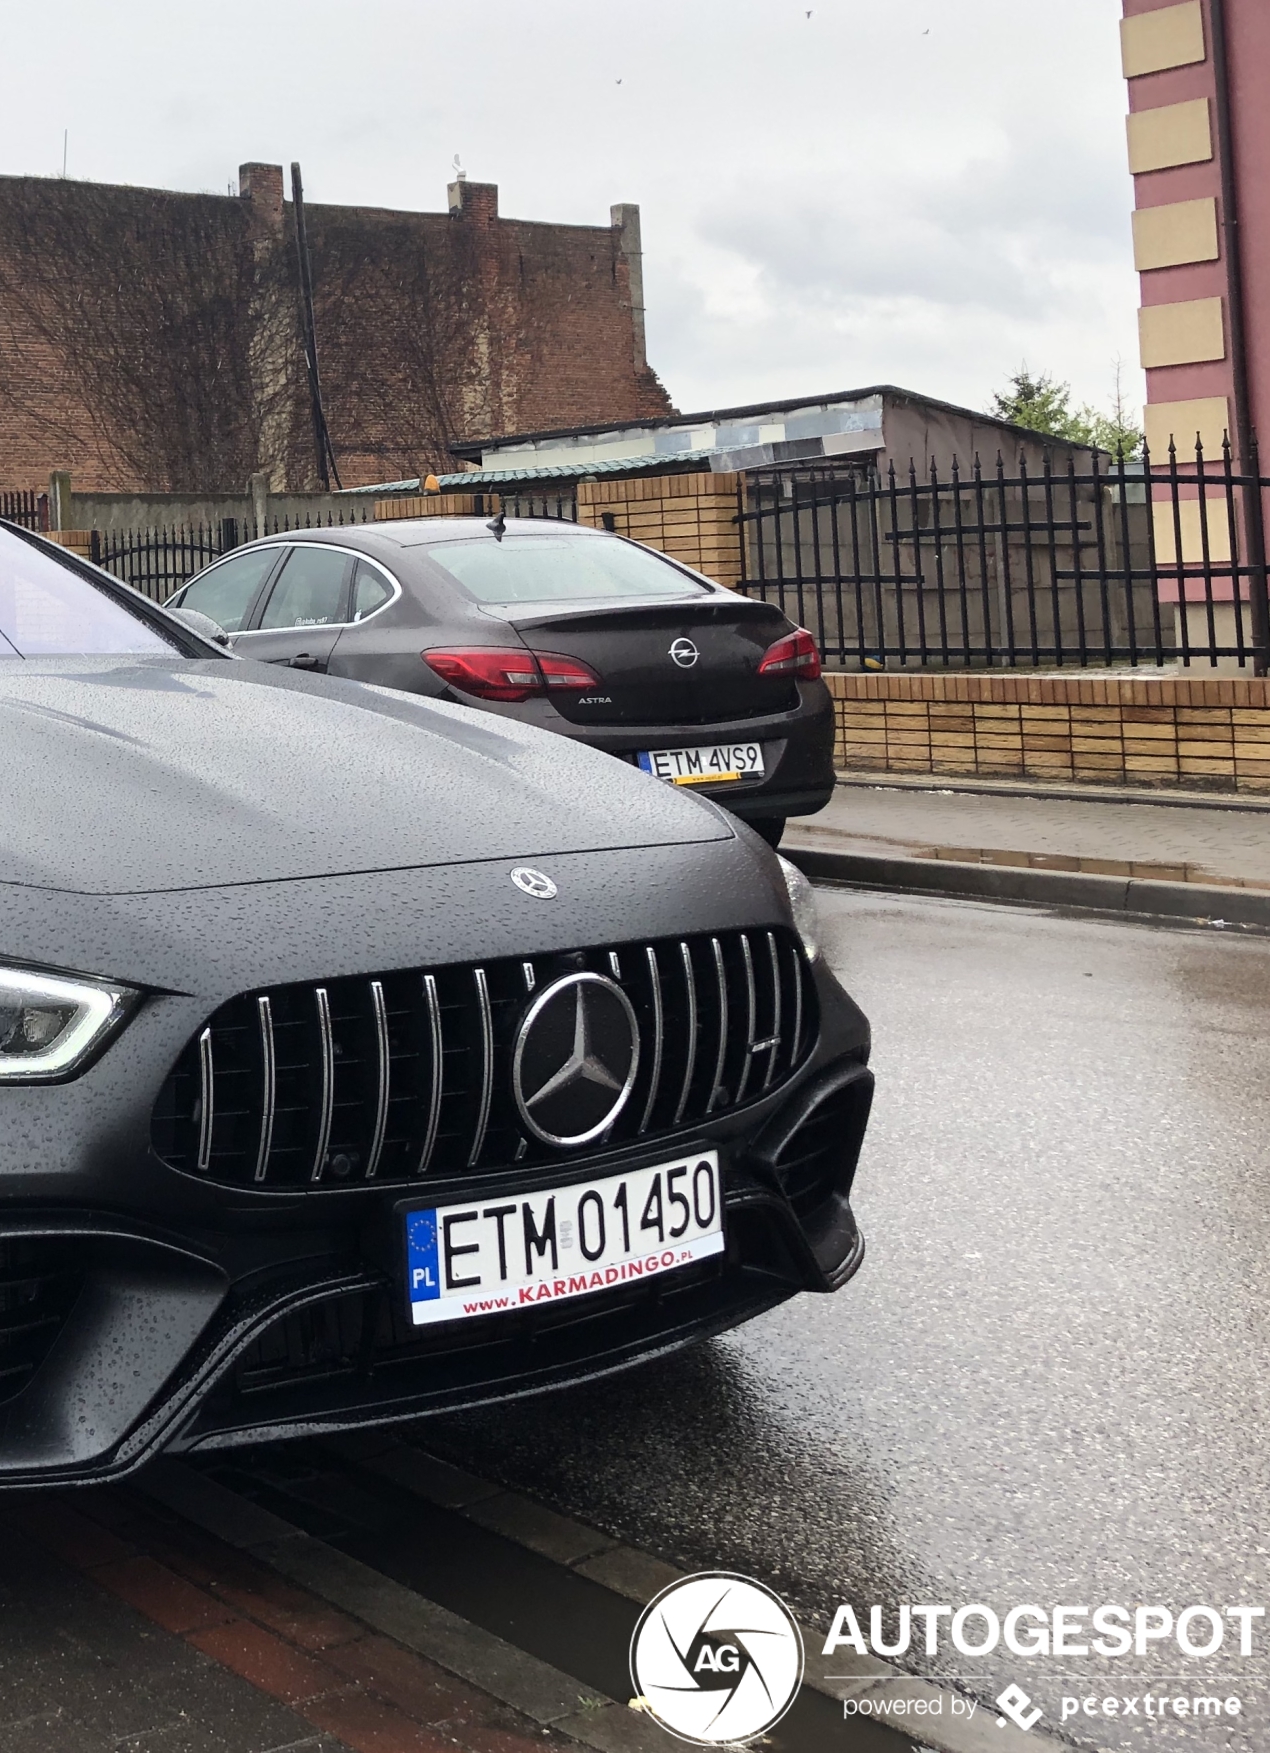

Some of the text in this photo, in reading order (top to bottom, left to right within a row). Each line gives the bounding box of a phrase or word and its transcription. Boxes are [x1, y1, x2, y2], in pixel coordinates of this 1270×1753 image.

[578, 696, 612, 705] ASTRA
[652, 746, 758, 777] ETM 4VS9
[442, 1160, 716, 1290] ETM 01450
[413, 1267, 436, 1289] PL
